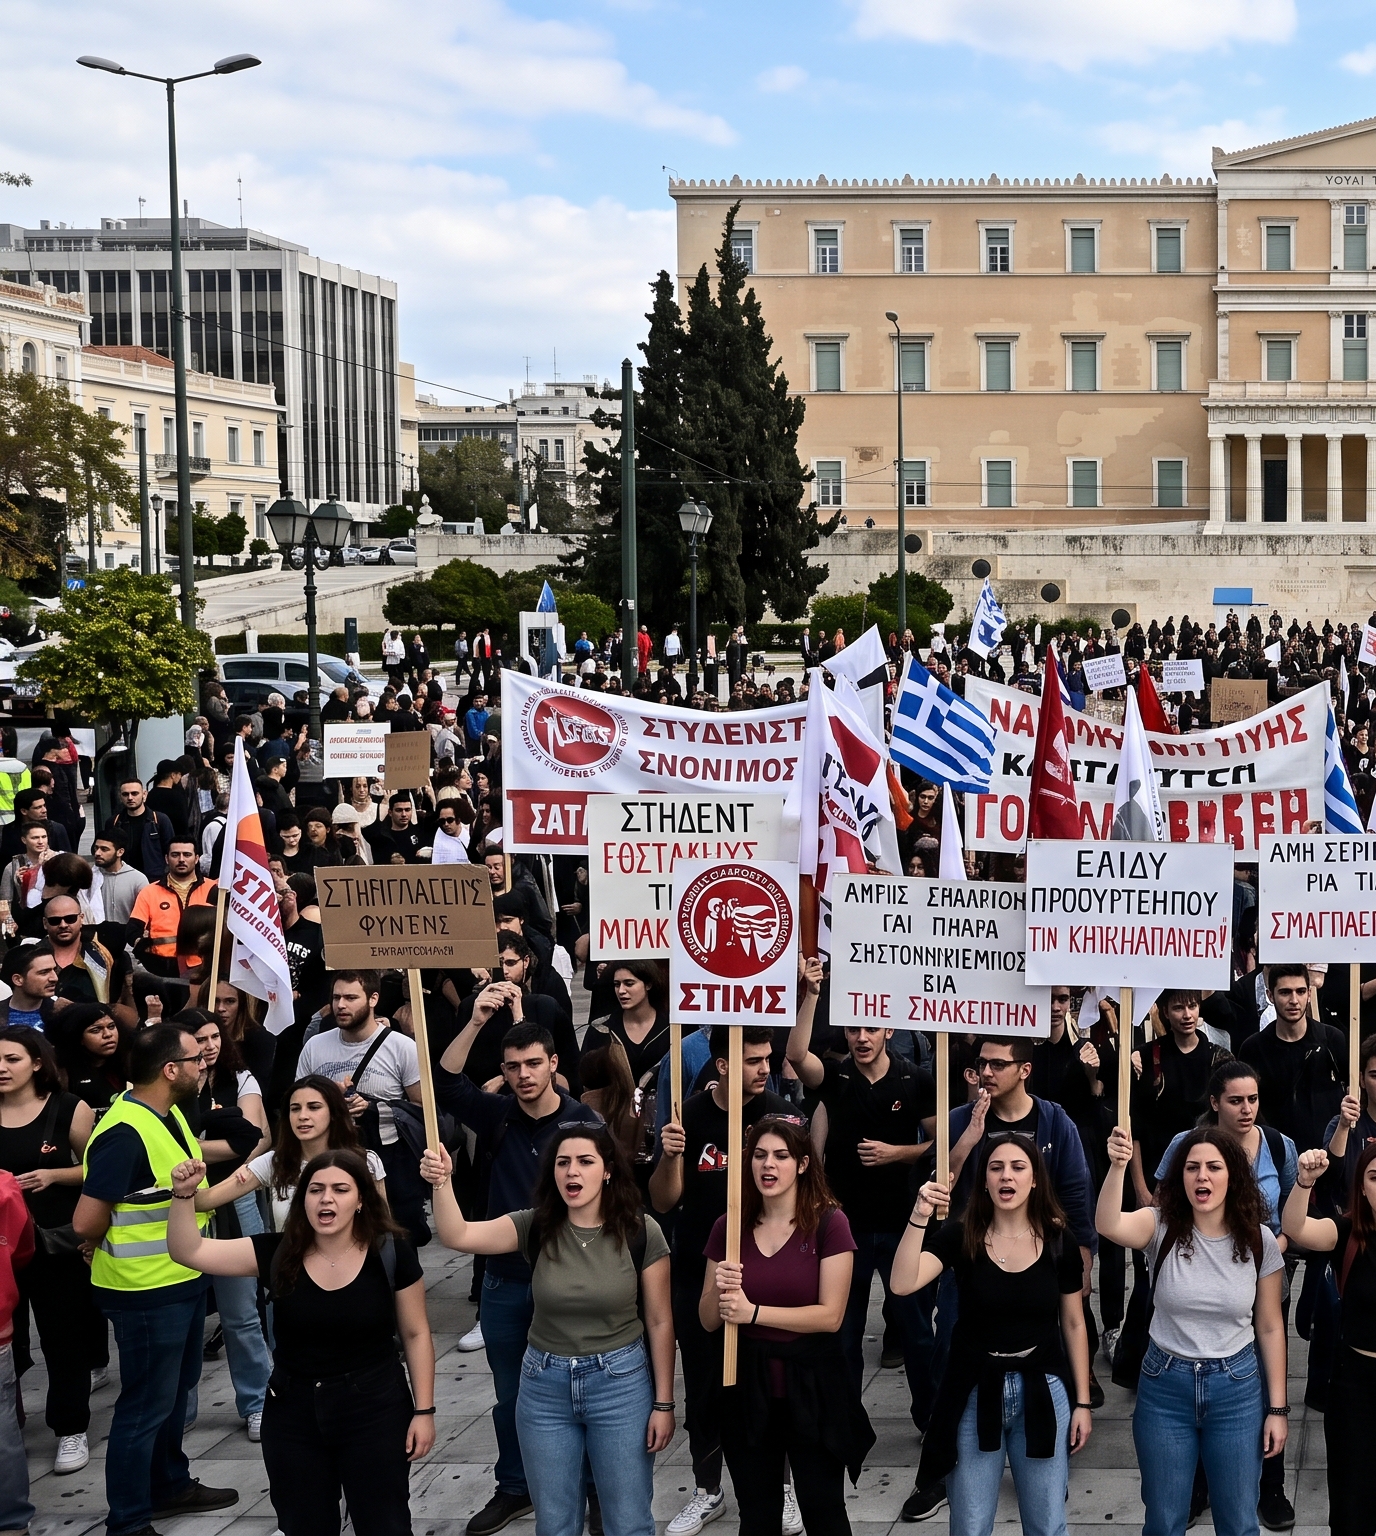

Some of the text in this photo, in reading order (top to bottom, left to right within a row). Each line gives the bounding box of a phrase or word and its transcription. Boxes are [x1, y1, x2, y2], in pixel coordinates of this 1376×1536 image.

[638, 750, 798, 783] ΣΝΟΝΙΜΟΣ
[620, 801, 755, 834] ΣΤΗΔΕΝΤ
[1076, 850, 1168, 881] ΕΑΙΔΥ
[1269, 842, 1315, 863] ΑΜΗ
[1306, 873, 1339, 892] ΡΙΑ
[882, 914, 912, 934] ΓΑΙ
[1028, 926, 1058, 953] ΤΙΝ
[923, 974, 957, 994] ΒΙΑ
[678, 983, 787, 1014] ΣΤΙΜΣ
[847, 992, 892, 1019] ΤΗΕ
